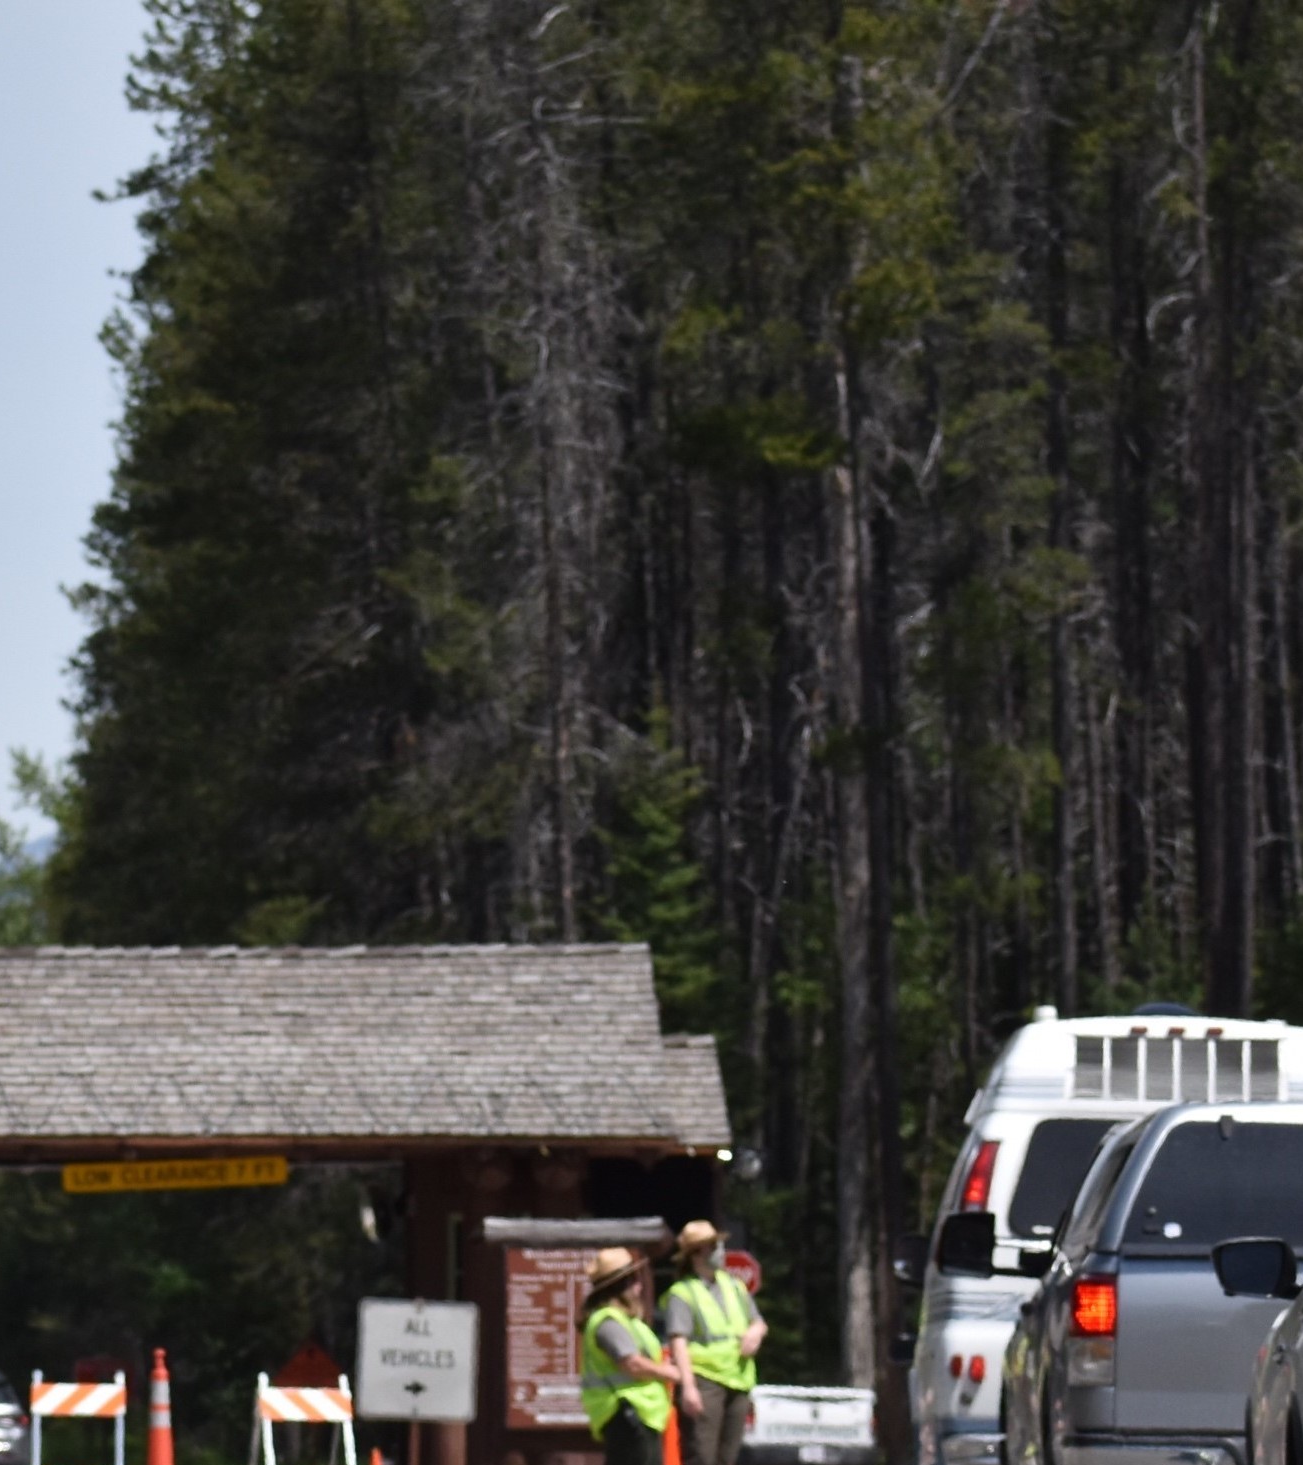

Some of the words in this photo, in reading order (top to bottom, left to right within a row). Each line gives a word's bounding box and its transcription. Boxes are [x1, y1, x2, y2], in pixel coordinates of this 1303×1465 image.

[72, 1166, 112, 1186] LOW
[120, 1163, 228, 1185] CLEARANCE
[404, 1318, 432, 1336] ALL
[380, 1348, 456, 1369] VEHICLES
